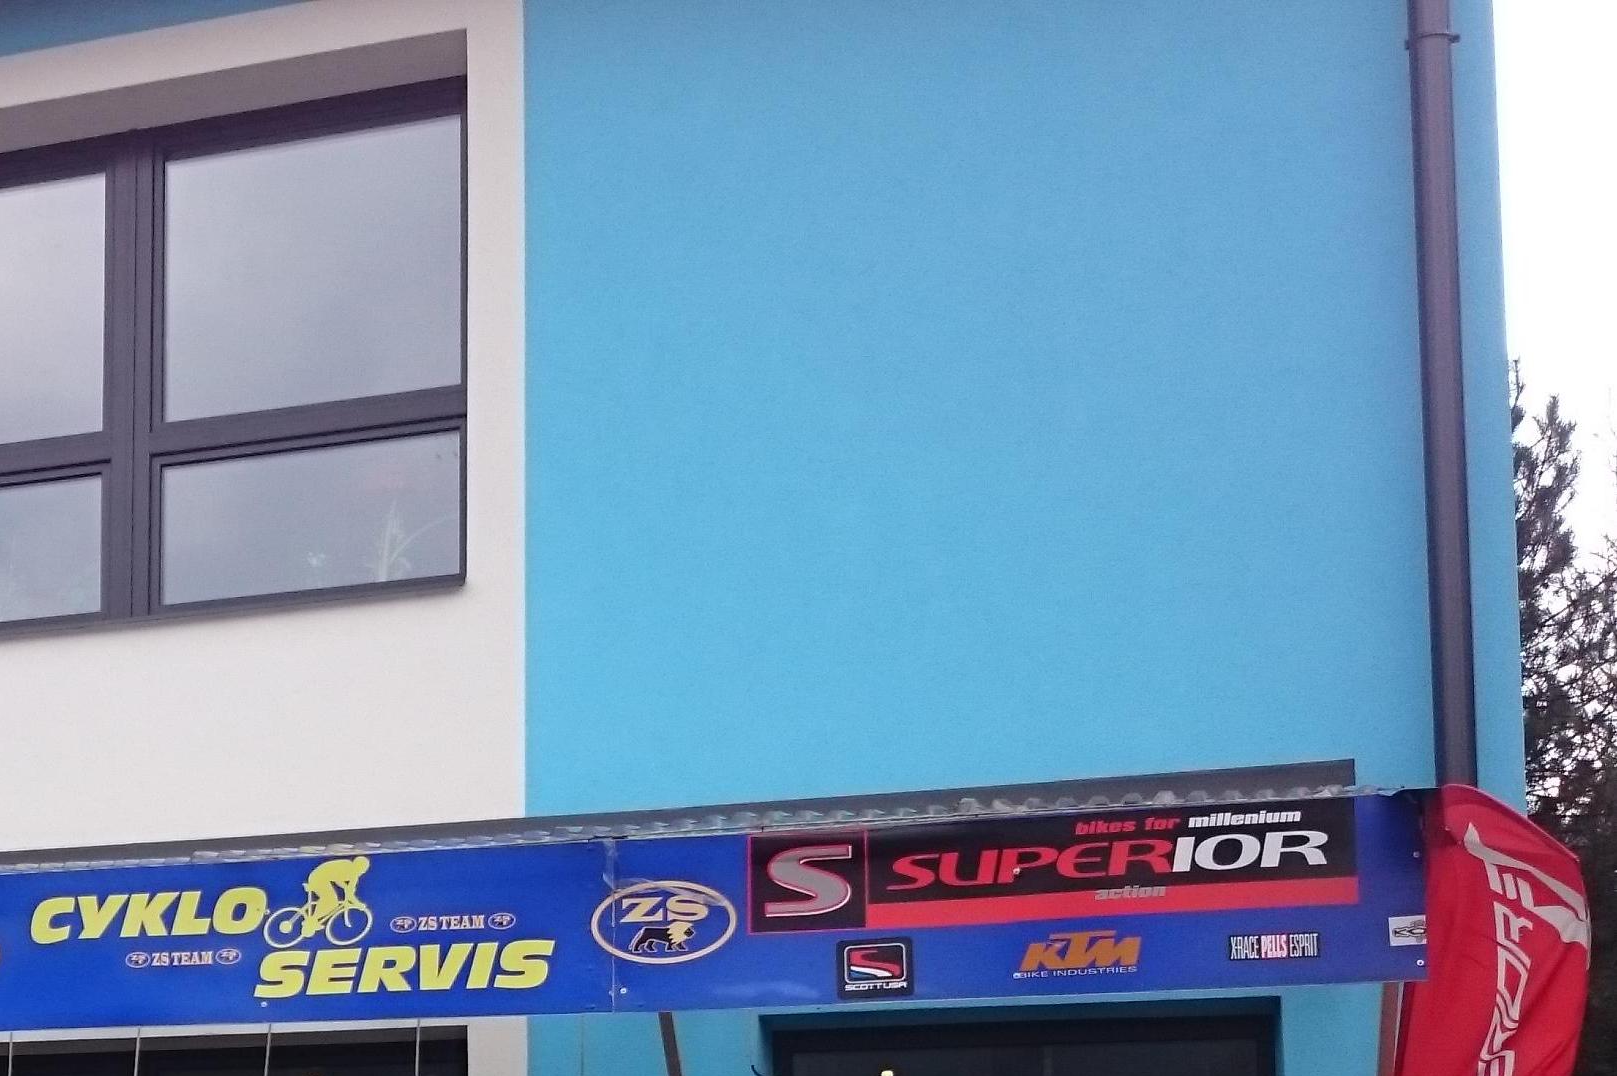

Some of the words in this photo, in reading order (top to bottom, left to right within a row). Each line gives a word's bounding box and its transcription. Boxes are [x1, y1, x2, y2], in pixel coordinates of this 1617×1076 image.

[1075, 819, 1136, 836] bikes
[1144, 817, 1180, 832] for
[1188, 810, 1301, 829] millenium
[885, 830, 1329, 891] SUPERIOR
[1094, 884, 1167, 901] action
[30, 887, 268, 945] CYKLO
[417, 915, 438, 931] ZS
[439, 914, 485, 930] TEAM
[620, 895, 710, 924] ZS
[1018, 929, 1142, 972] KTM
[1260, 934, 1289, 959] PELLS
[1289, 932, 1319, 957] ESPRIT
[151, 951, 170, 967] ZS
[171, 951, 213, 966] TEAM
[254, 939, 556, 998] SERVIS
[1019, 970, 1048, 979] BIKE
[1053, 966, 1138, 978] INDUSTRIES
[844, 983, 883, 992] SCOTT
